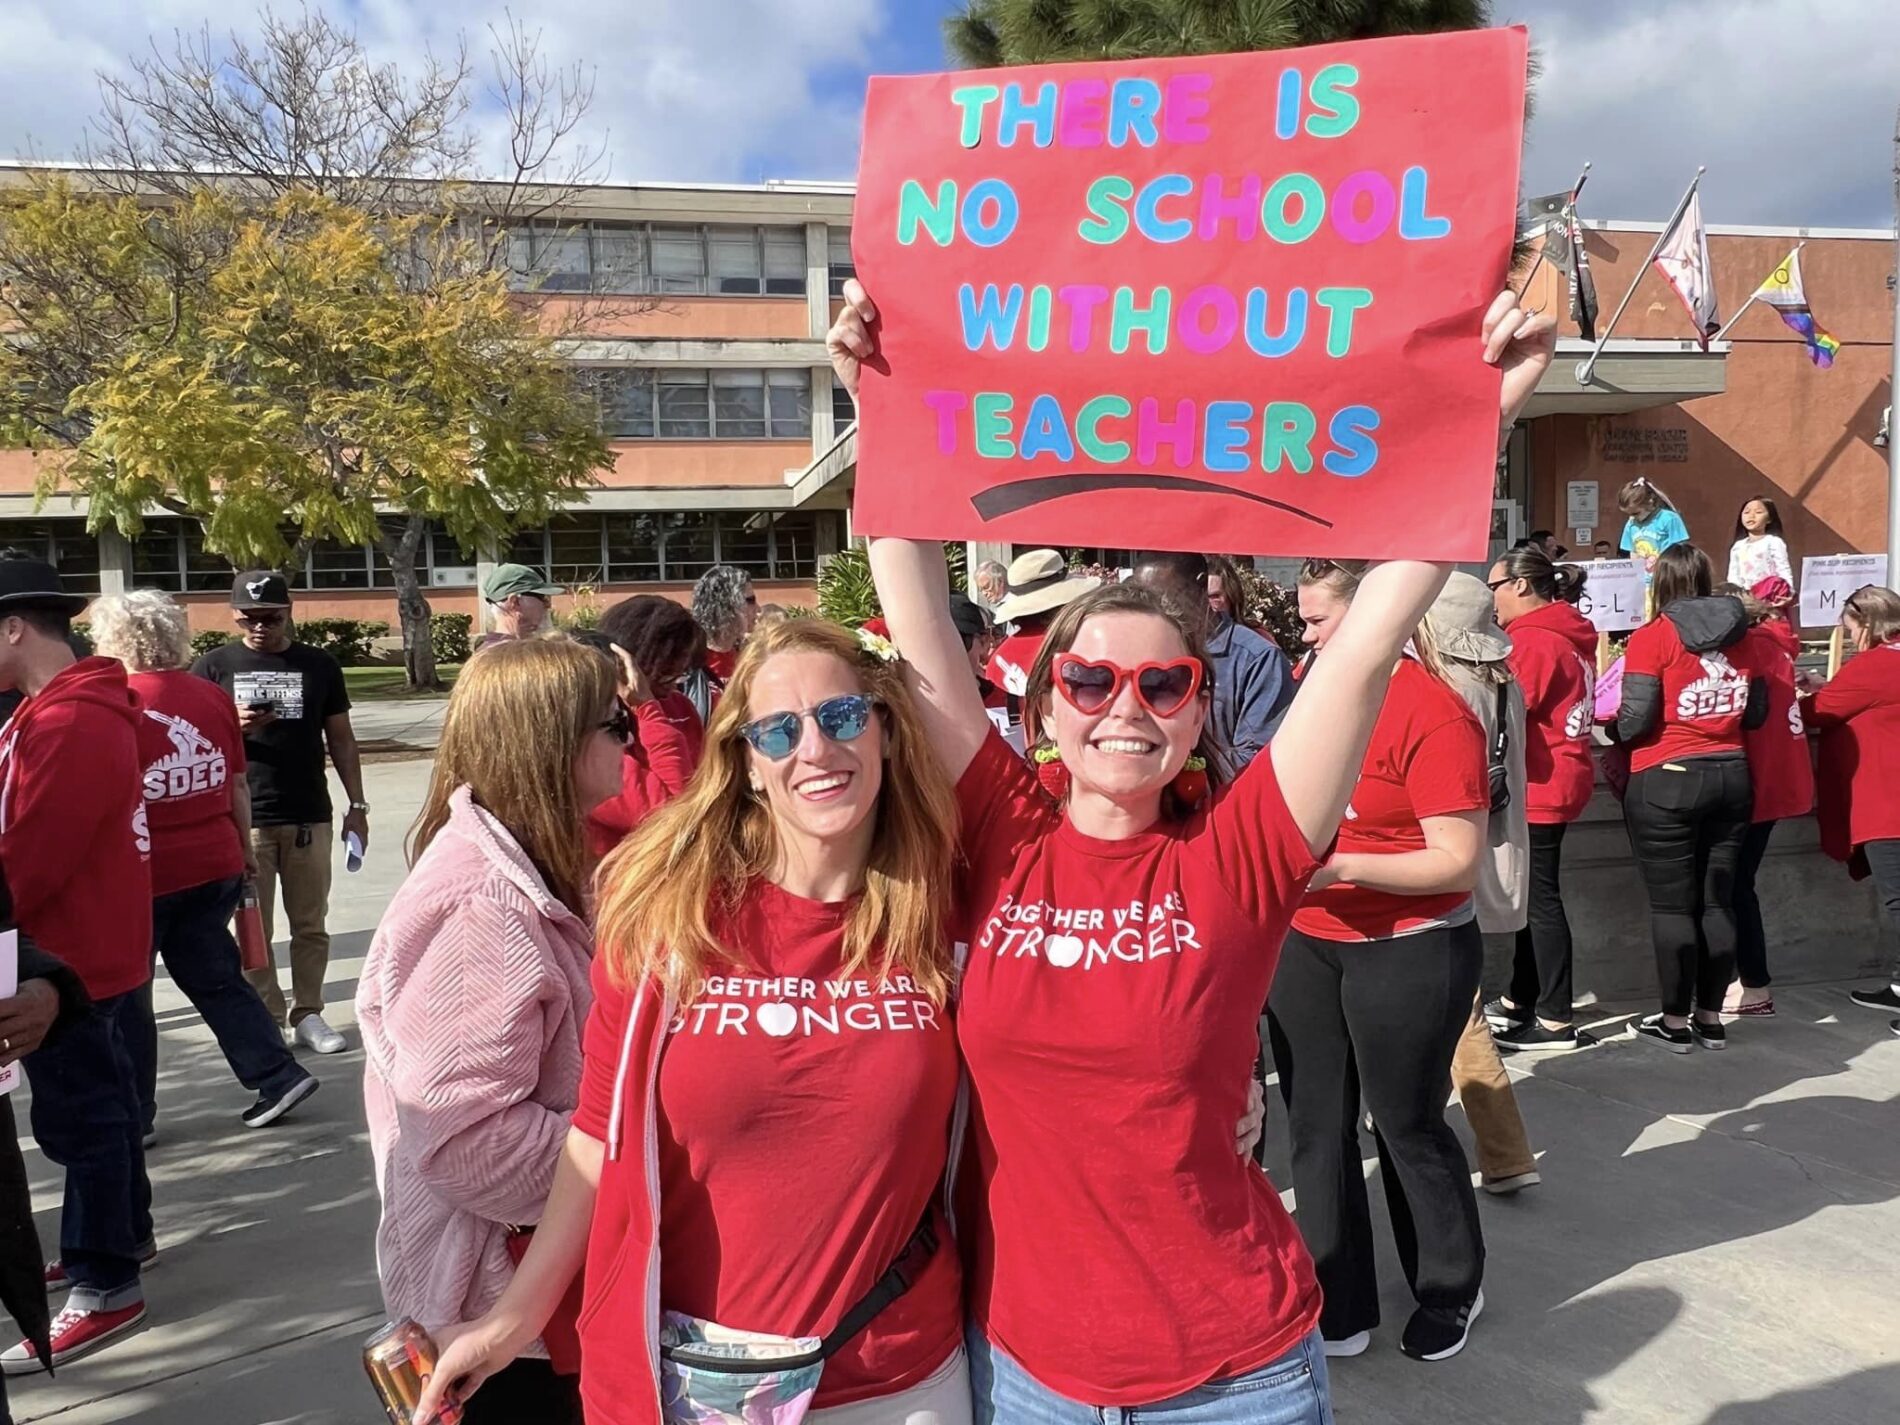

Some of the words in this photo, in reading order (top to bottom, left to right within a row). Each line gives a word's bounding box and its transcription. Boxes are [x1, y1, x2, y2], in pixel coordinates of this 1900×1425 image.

[951, 73, 1212, 149] THERE
[1274, 63, 1360, 139] IS
[897, 178, 1019, 246] NO
[1078, 165, 1452, 244] SCHOOL
[958, 283, 1373, 359] WITHOUT
[924, 389, 1381, 478] TEACHERS
[1677, 686, 1749, 717] SDEA
[142, 757, 227, 801] SDEA
[1000, 894, 1104, 930] TOGTHER
[697, 975, 816, 998] OGETHER
[824, 980, 870, 999] WE
